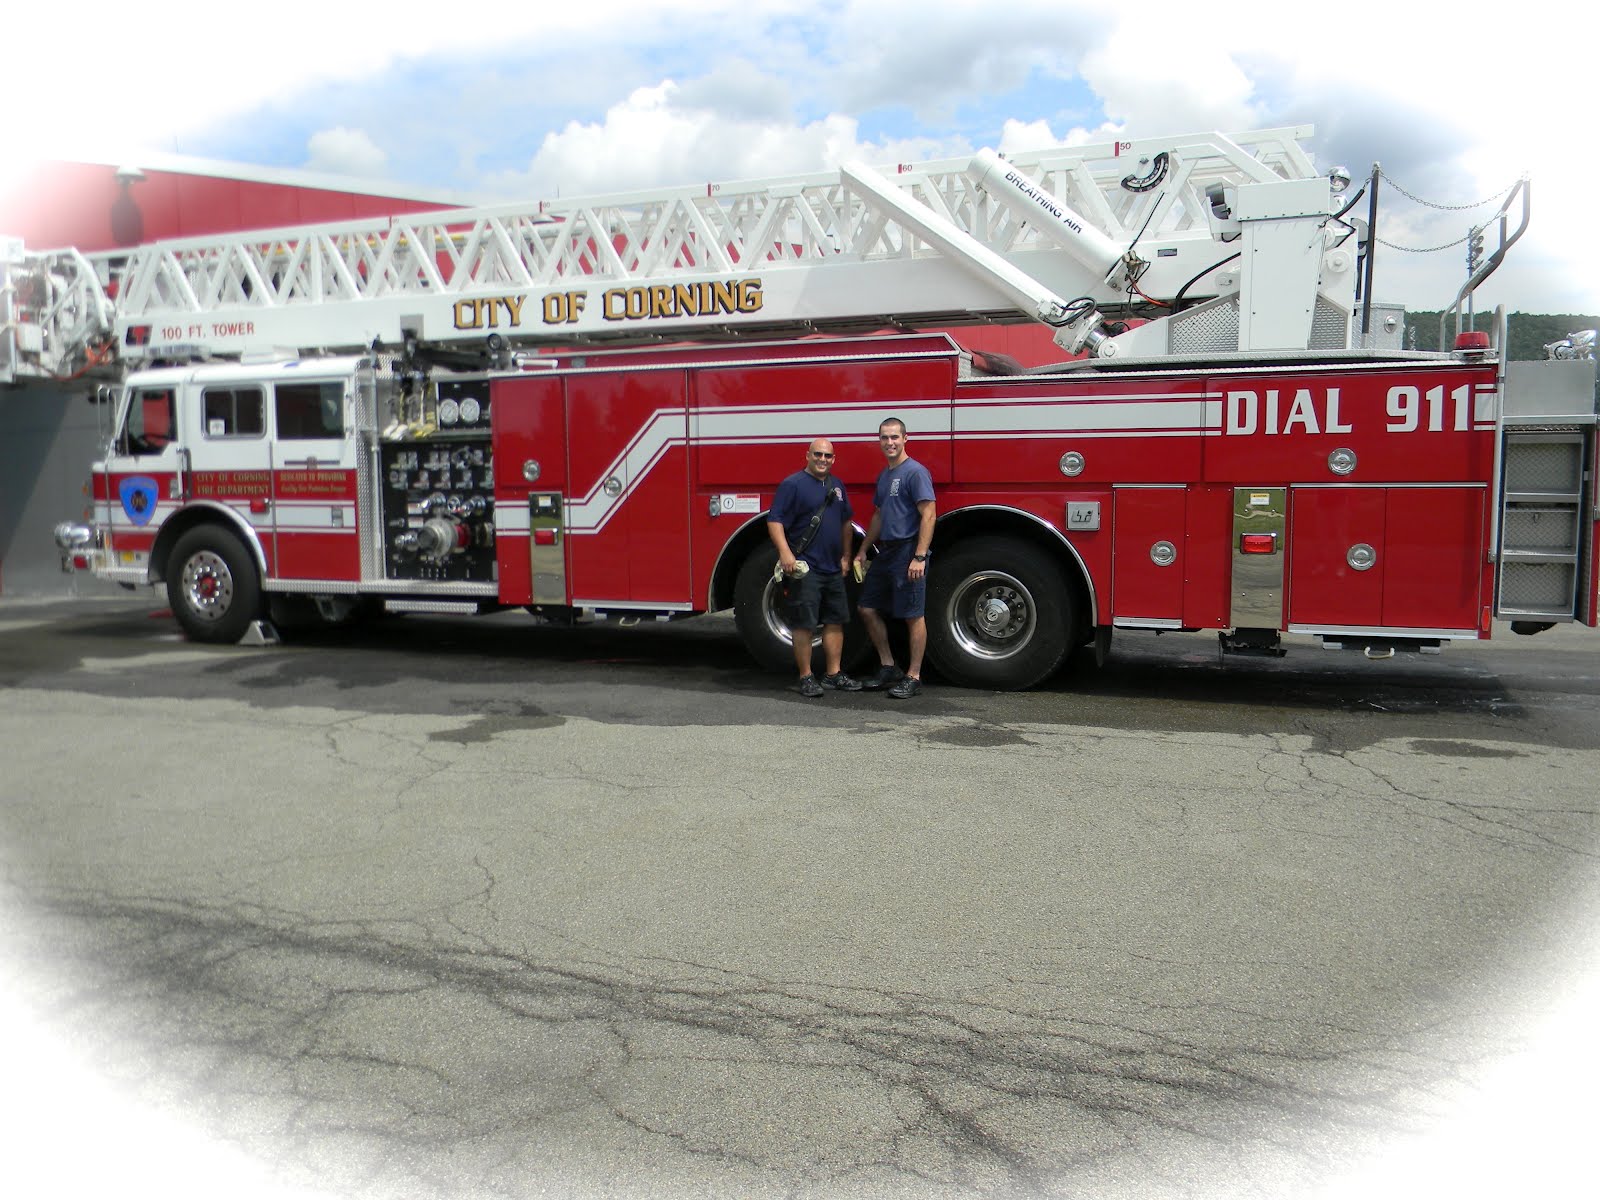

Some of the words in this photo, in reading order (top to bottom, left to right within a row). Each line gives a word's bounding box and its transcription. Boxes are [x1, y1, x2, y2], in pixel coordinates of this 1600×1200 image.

[1120, 142, 1131, 150] 50
[1005, 171, 1064, 218] BREATHING
[1064, 217, 1084, 234] AIR
[453, 294, 527, 330] CITY
[542, 290, 588, 324] OF
[602, 277, 764, 322] CORNING
[162, 327, 182, 340] 100
[188, 325, 206, 338] FT.
[212, 321, 254, 336] TOWER
[1226, 387, 1353, 436] DIAL
[1385, 384, 1469, 433] 911
[196, 472, 214, 482] CITY
[233, 472, 270, 482] CORNING
[217, 484, 269, 495] DEPARTMENT
